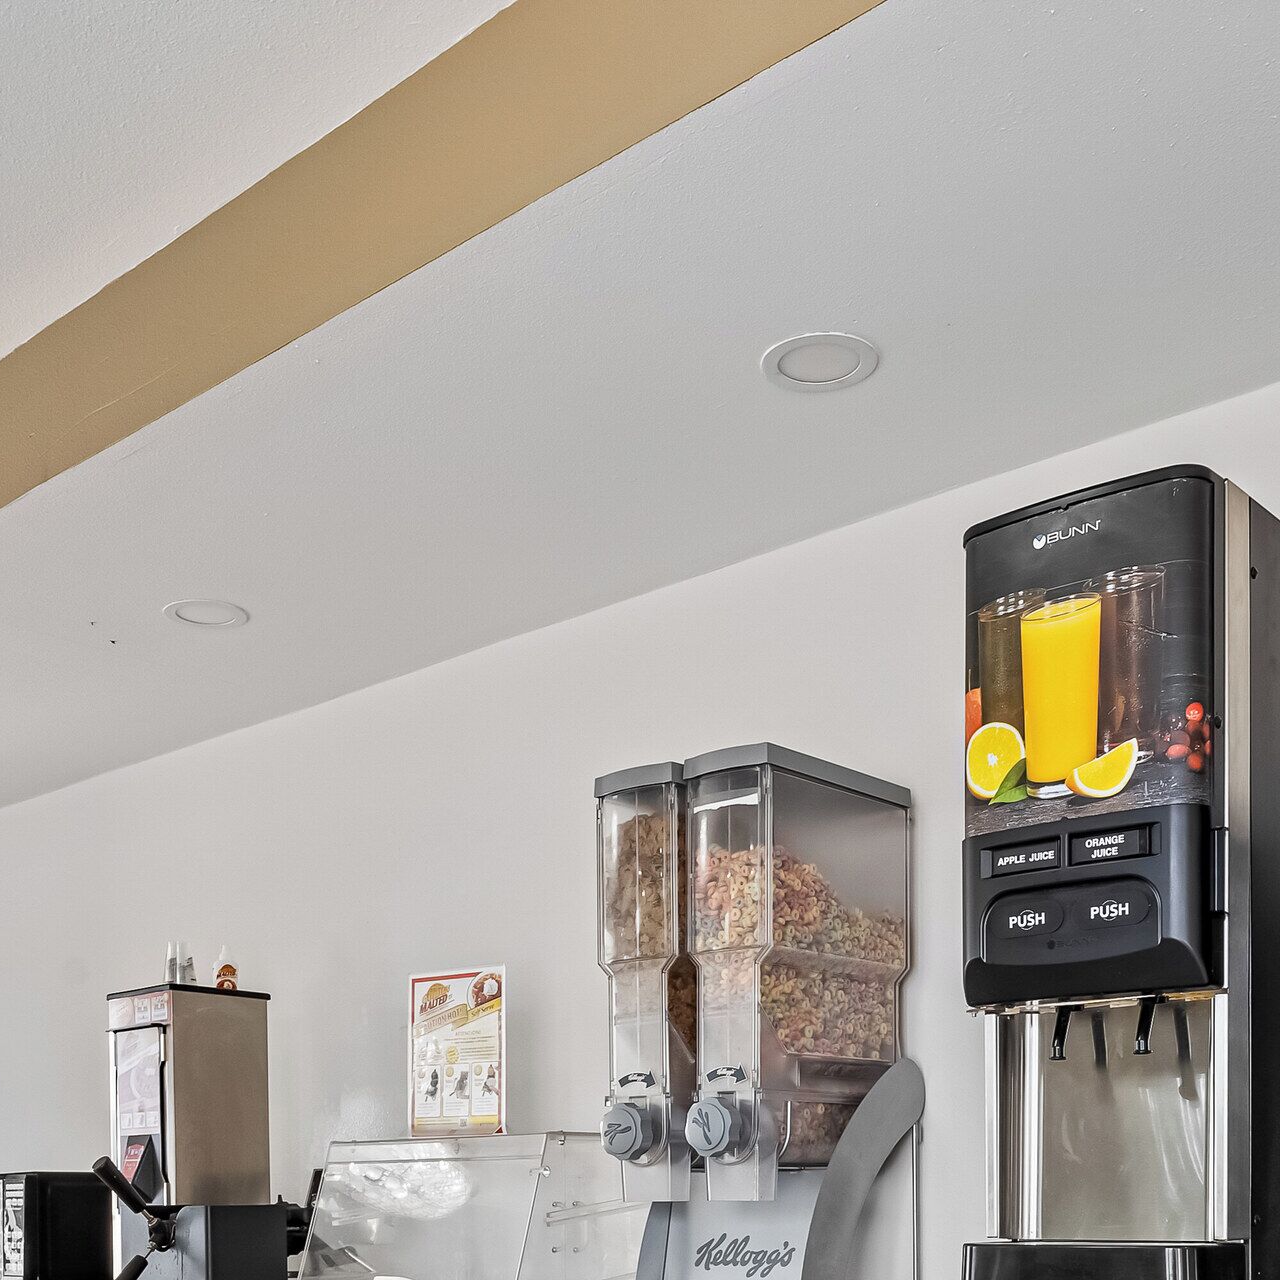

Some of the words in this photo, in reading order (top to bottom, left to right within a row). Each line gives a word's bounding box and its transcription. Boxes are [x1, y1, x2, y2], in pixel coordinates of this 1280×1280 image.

[1046, 520, 1102, 545] BUNN
[1085, 834, 1125, 848] ORANGE
[997, 854, 1026, 867] APPLE
[1028, 850, 1055, 862] JUICE
[1091, 847, 1119, 858] JUICE
[1090, 902, 1130, 920] PUSH
[1009, 912, 1046, 929] PUSH
[694, 1232, 797, 1278] Kellogg's
